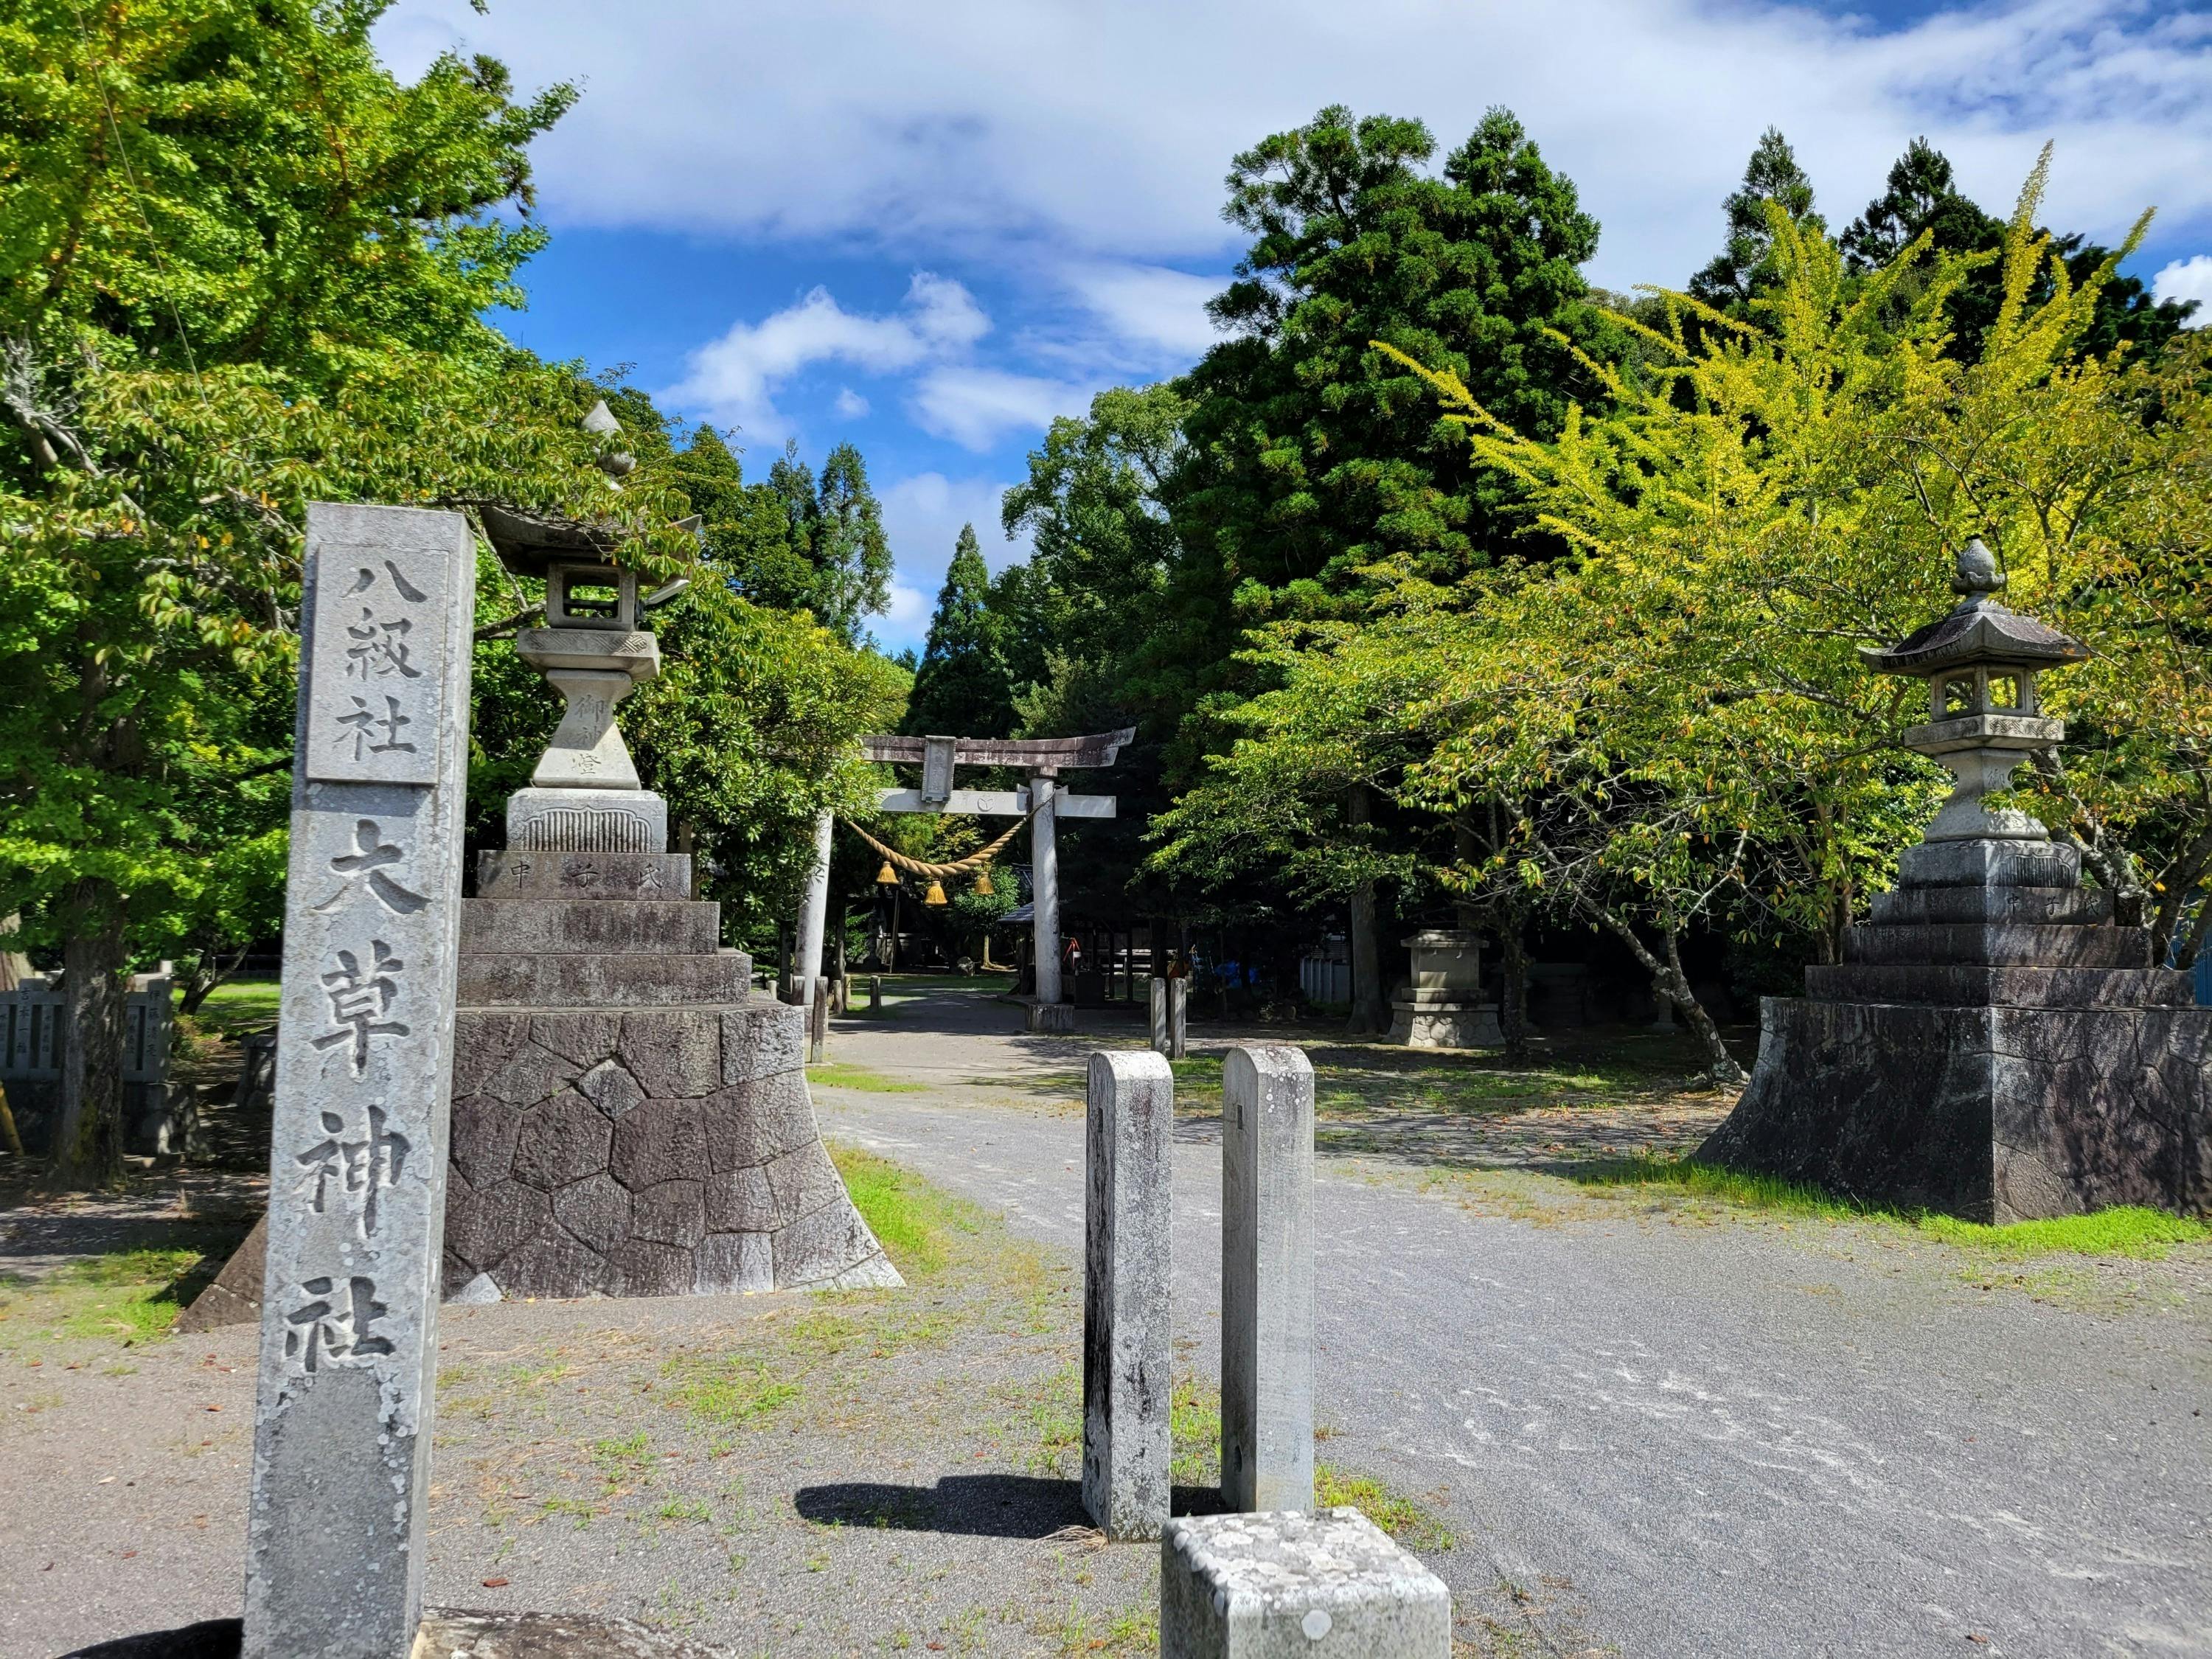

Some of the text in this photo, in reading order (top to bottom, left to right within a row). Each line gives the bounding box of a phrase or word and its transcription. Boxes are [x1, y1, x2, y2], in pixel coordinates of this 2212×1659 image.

[333, 559, 428, 762] 八級社
[285, 818, 434, 1373] 大草神社
